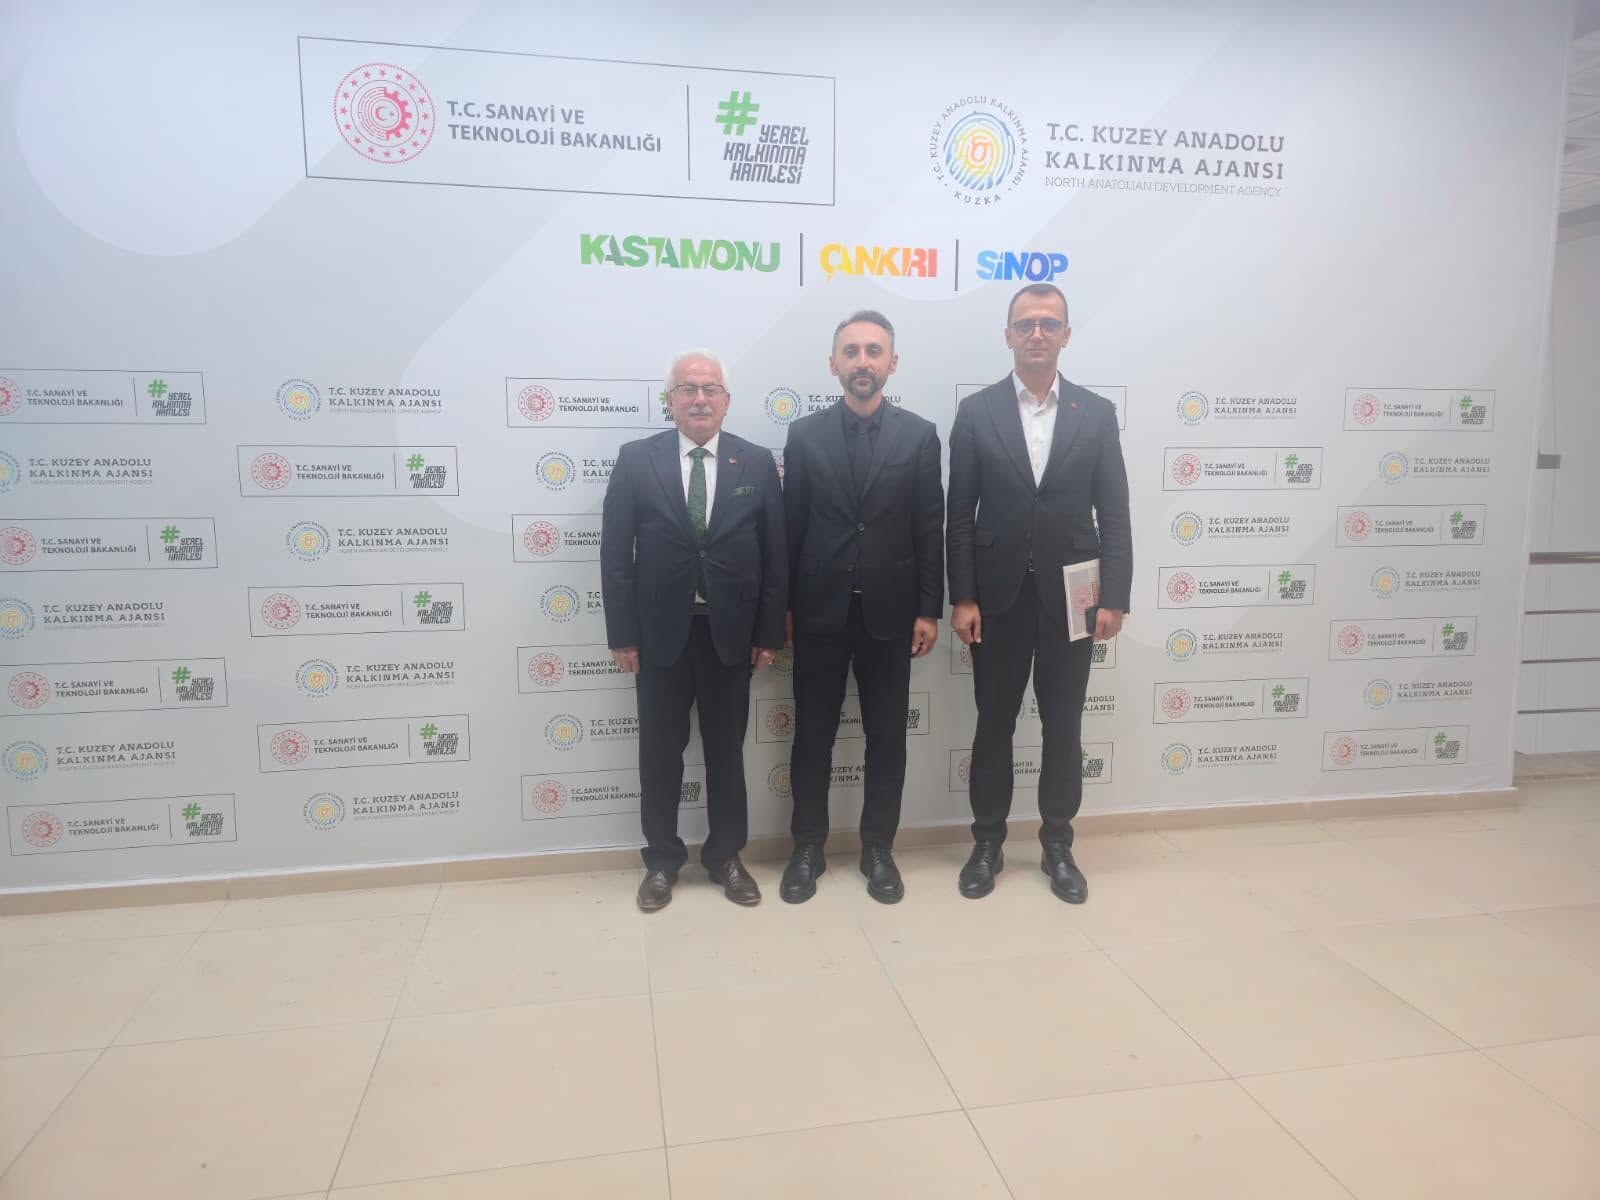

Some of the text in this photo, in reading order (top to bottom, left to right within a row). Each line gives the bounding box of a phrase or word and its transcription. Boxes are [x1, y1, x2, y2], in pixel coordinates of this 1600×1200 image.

[447, 100, 584, 125] T.C. SANAYİ VE
[448, 124, 661, 152] TEKNOLOJİ BAKANLIĞI
[1047, 123, 1284, 152] T.C. KUZEY ANADOLU
[724, 142, 806, 164] KALKINMA
[1046, 151, 1283, 179] KALKINMA AJANSI
[1045, 177, 1085, 188] NORTH
[1088, 179, 1151, 191] ANATOLIAN
[954, 191, 1001, 205] KUZKA
[580, 233, 780, 272] KASTAMONU
[819, 243, 937, 283] ÇANKIRI
[44, 389, 75, 397] SANAYİ
[329, 387, 440, 396] T.C. KUZEY ANADOLU
[28, 398, 122, 406] TEKNOLOJİ BAKANLIĞI
[329, 399, 394, 407] KALKINMA
[30, 470, 100, 478] KALKINMA
[358, 528, 392, 536] KUZEY
[397, 528, 448, 536] ANADOLU
[338, 538, 449, 546] KALKINMA AJANSI
[43, 603, 163, 613] T.C. KUZEY ANADOLU
[44, 613, 165, 623] KALKINMA AJANSI
[367, 664, 400, 672] KUZEY
[404, 662, 454, 671] ANADOLU
[347, 671, 454, 683] KALKINMA AJANSI
[591, 728, 639, 736] KALKINM
[56, 741, 174, 754] T.C. KUZEY ANADOLU
[57, 752, 175, 764] KALKINMA AJANSI
[373, 794, 406, 803] KUZEY
[410, 792, 459, 801] ANADOLU
[353, 801, 460, 815] KALKINMA AJANSI
